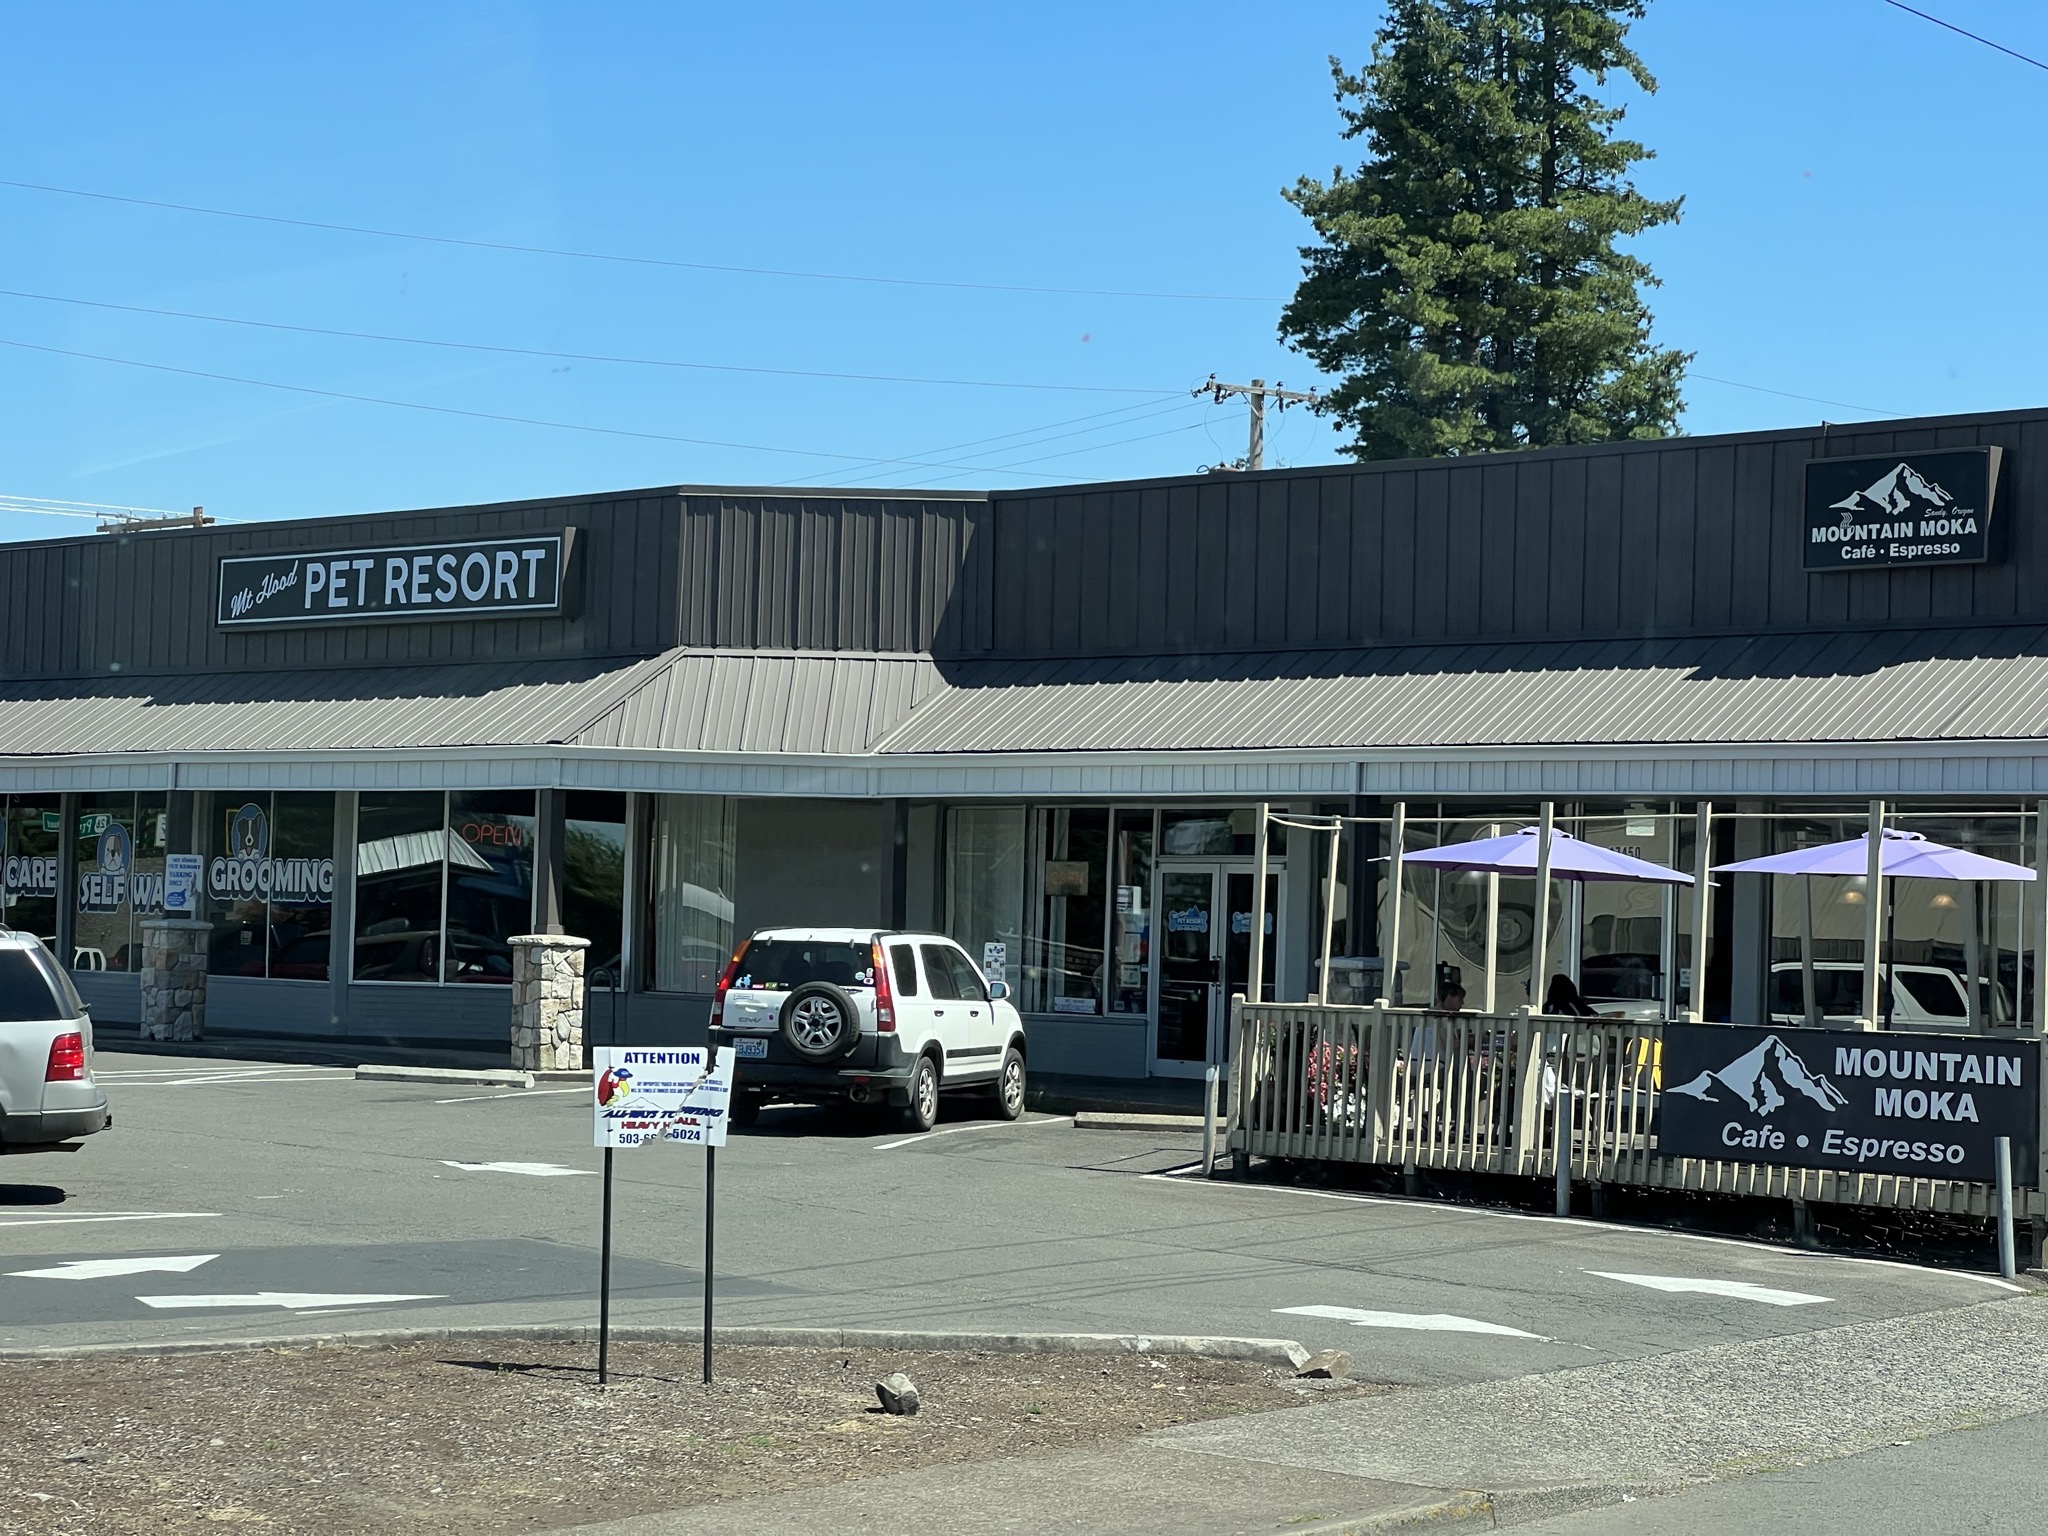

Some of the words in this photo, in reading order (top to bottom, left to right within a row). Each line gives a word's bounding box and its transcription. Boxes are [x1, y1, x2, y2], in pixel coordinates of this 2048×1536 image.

[1951, 505, 1974, 515] Oregon
[1811, 521, 1914, 543] MOUNTAIN
[1919, 517, 1978, 537] MOKA
[1841, 544, 1876, 560] Café
[1889, 543, 1961, 560] Espresso
[230, 587, 254, 618] Mt
[255, 559, 299, 604] Hood
[304, 558, 374, 609] PET
[384, 549, 546, 605] RESORT
[462, 823, 523, 847] OPEN
[1609, 845, 1641, 859] 7450
[6, 857, 58, 894] CARE
[79, 873, 126, 910] SELF
[130, 873, 164, 911] WA
[209, 858, 333, 900] GROOMING
[624, 1051, 701, 1065] ATTENTION
[1834, 1046, 2022, 1087] MOUNTAIN
[1874, 1088, 1979, 1123] MOKA
[621, 1121, 660, 1129] HEAVY
[1721, 1121, 1786, 1150] Cafe
[1821, 1129, 1966, 1165] Espresso
